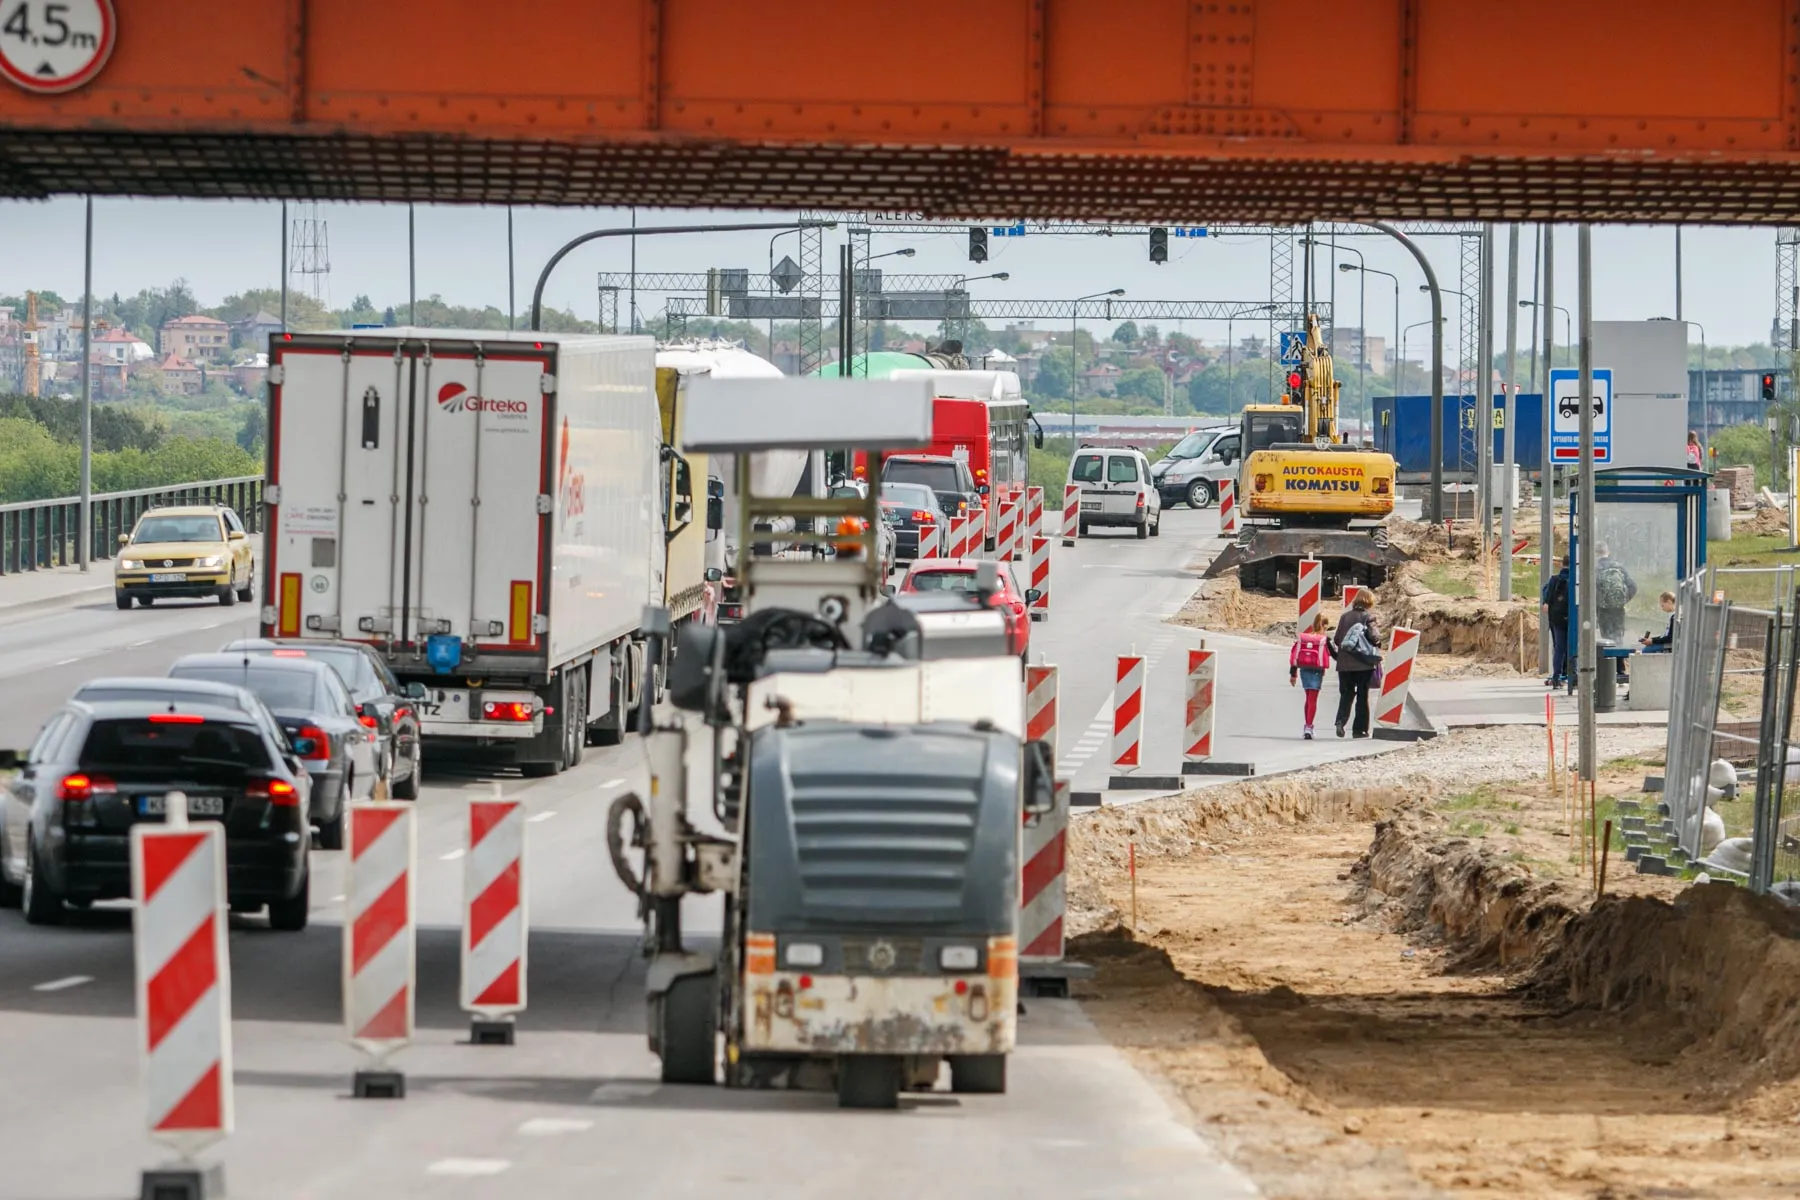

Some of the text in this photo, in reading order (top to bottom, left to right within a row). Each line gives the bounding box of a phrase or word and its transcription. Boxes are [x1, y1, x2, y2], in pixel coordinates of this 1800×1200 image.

[465, 395, 528, 413] Girteka
[1283, 466, 1364, 477] AUTOKAUSTA
[1285, 479, 1360, 492] KOMATSU
